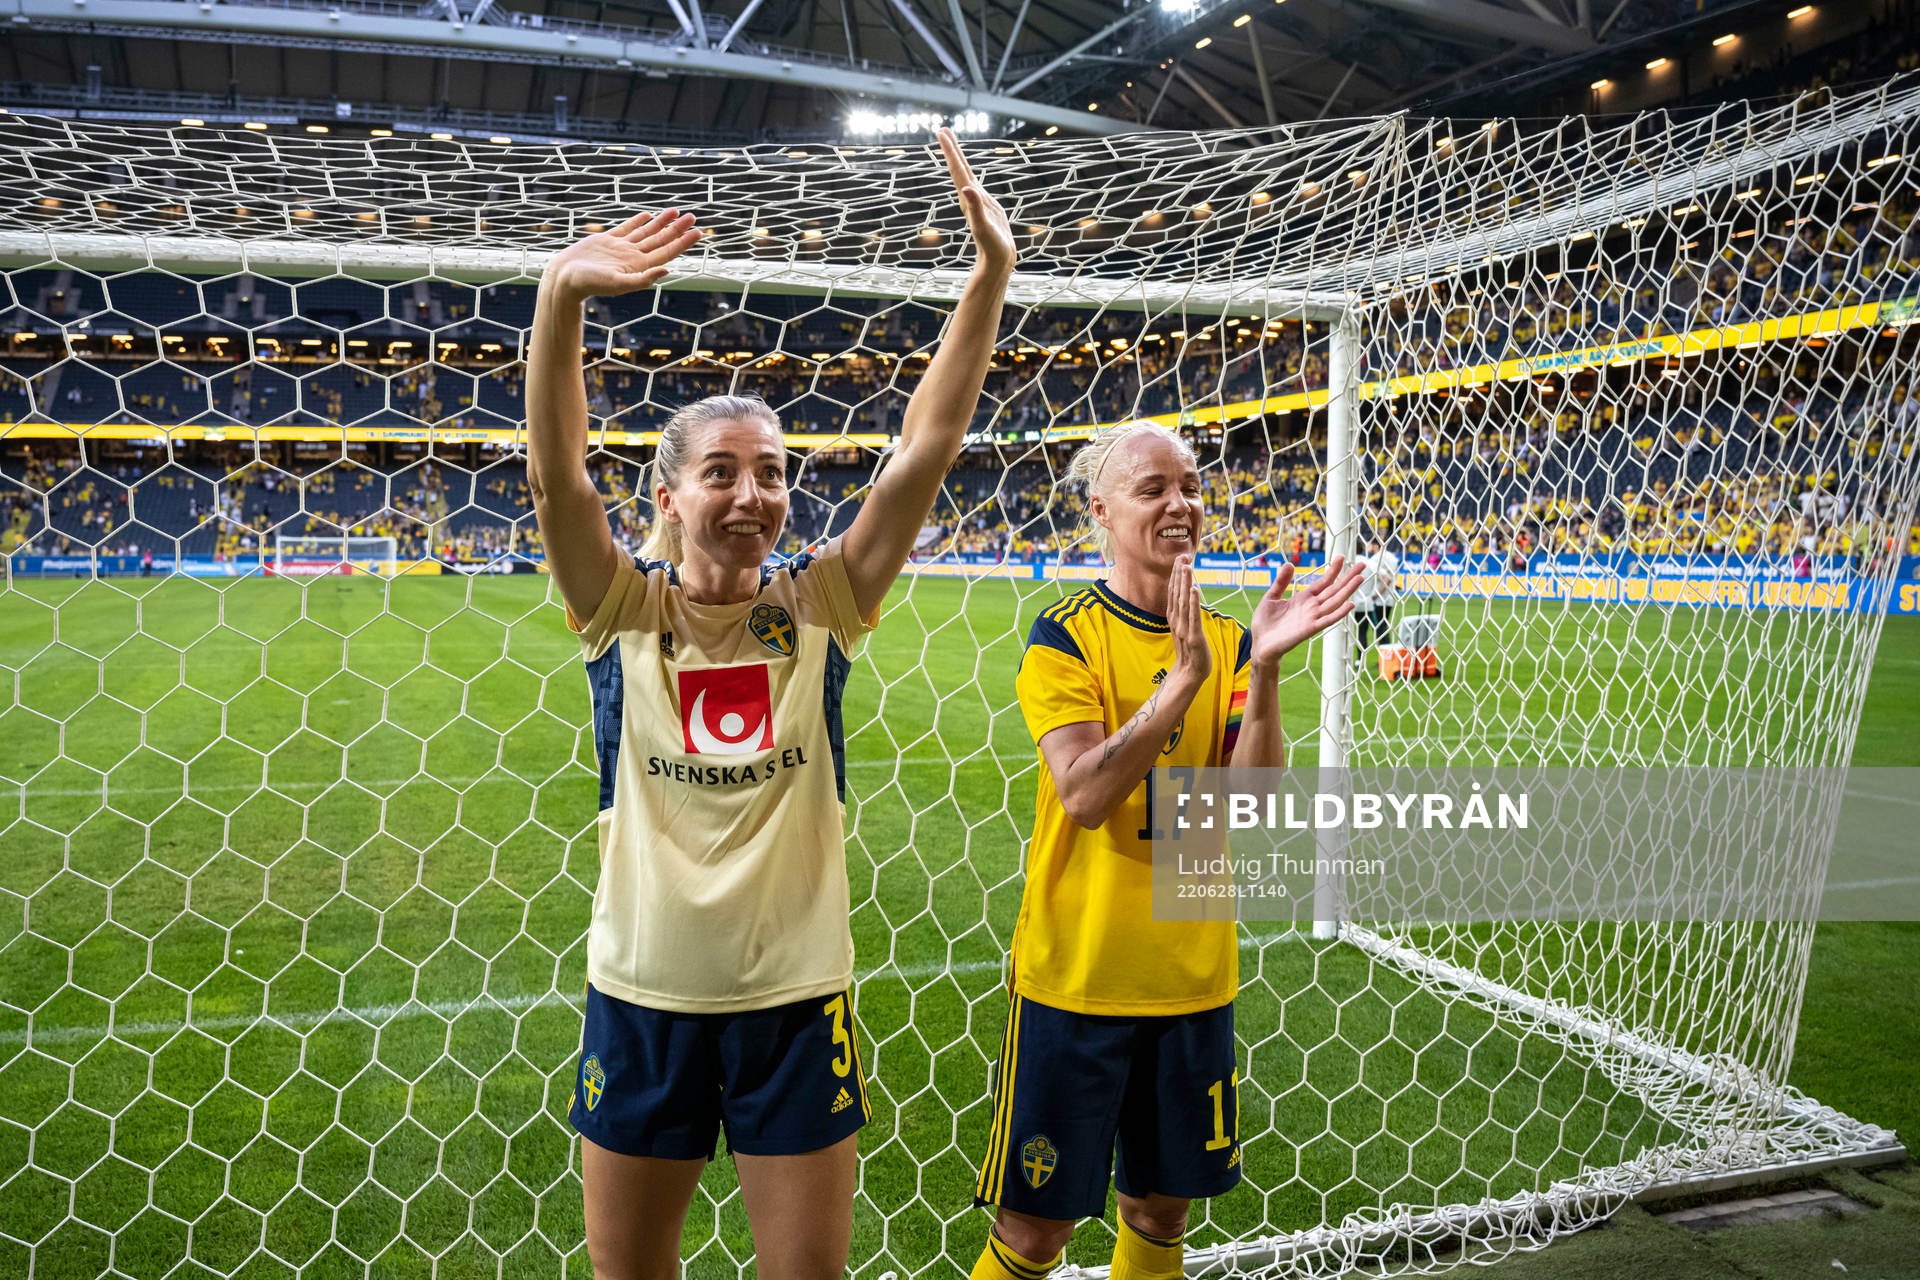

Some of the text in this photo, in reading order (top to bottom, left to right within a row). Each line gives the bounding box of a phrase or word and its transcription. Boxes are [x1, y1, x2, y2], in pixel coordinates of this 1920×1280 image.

[648, 746, 808, 784] SVENSKA SEL
[1138, 766, 1195, 840] 17
[823, 994, 852, 1078] 3
[831, 1096, 853, 1114] adidas
